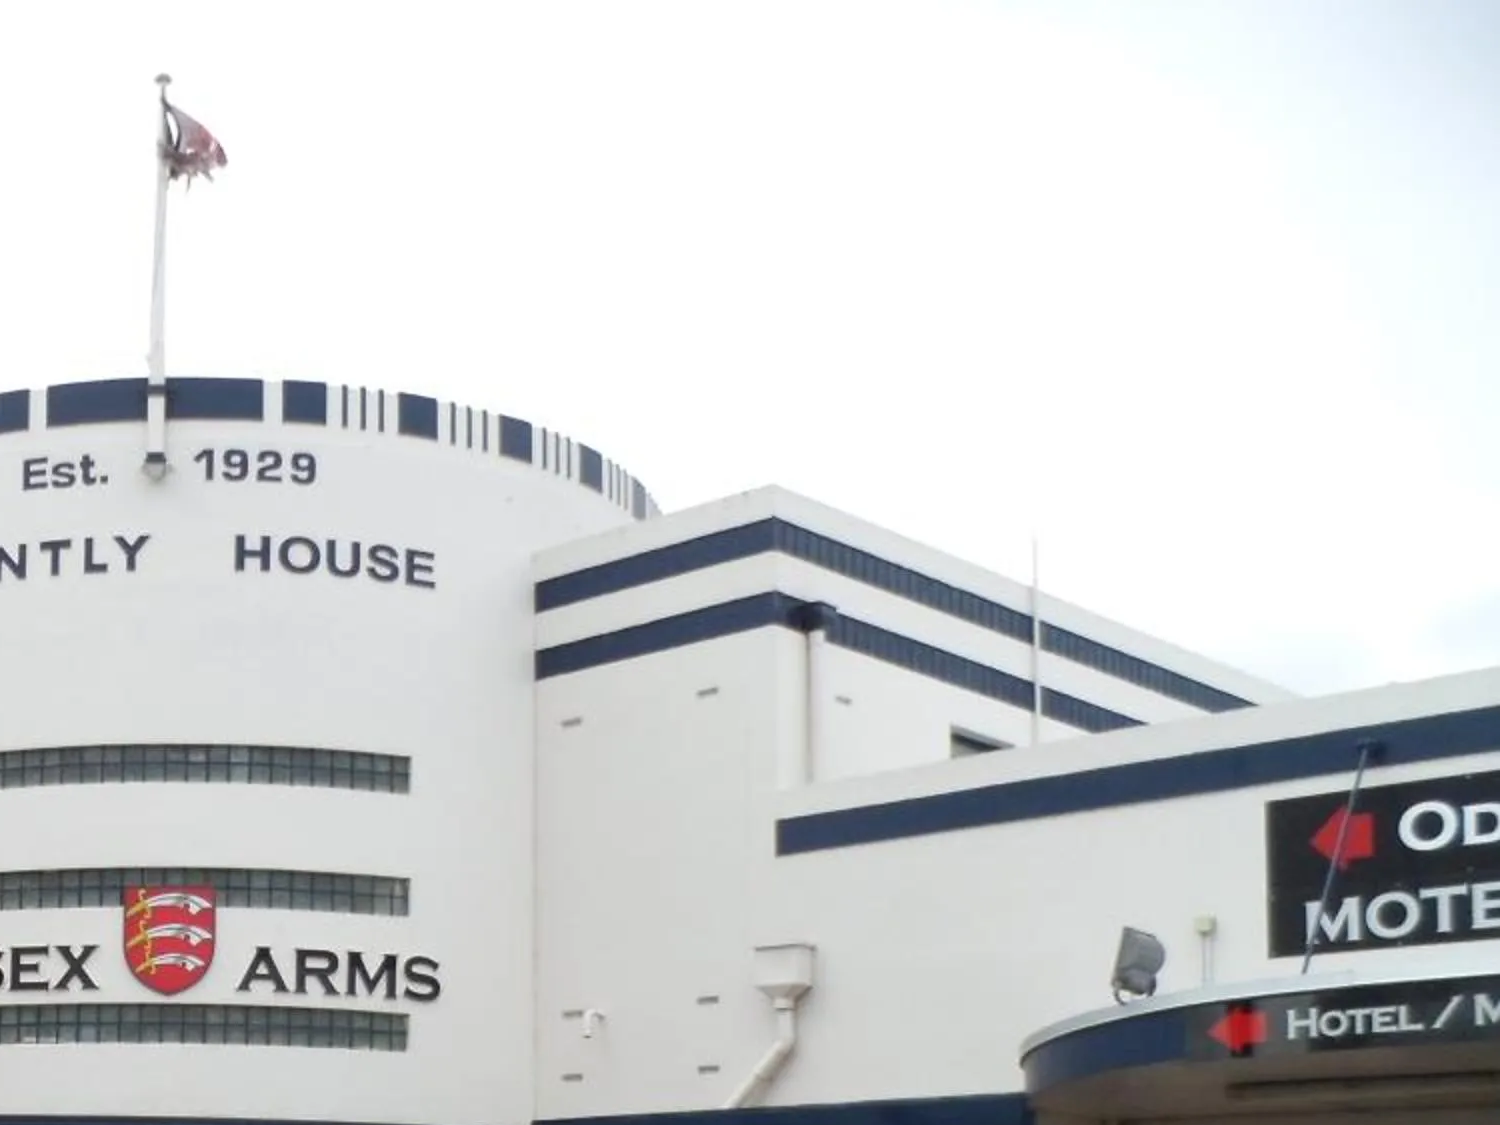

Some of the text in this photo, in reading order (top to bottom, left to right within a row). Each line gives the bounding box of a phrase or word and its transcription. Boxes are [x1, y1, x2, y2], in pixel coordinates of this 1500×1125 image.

[22, 448, 318, 491] Est. 1929
[233, 533, 438, 589] HOUSE
[235, 945, 443, 1003] ARMS
[1286, 1004, 1425, 1041] HOTEL
